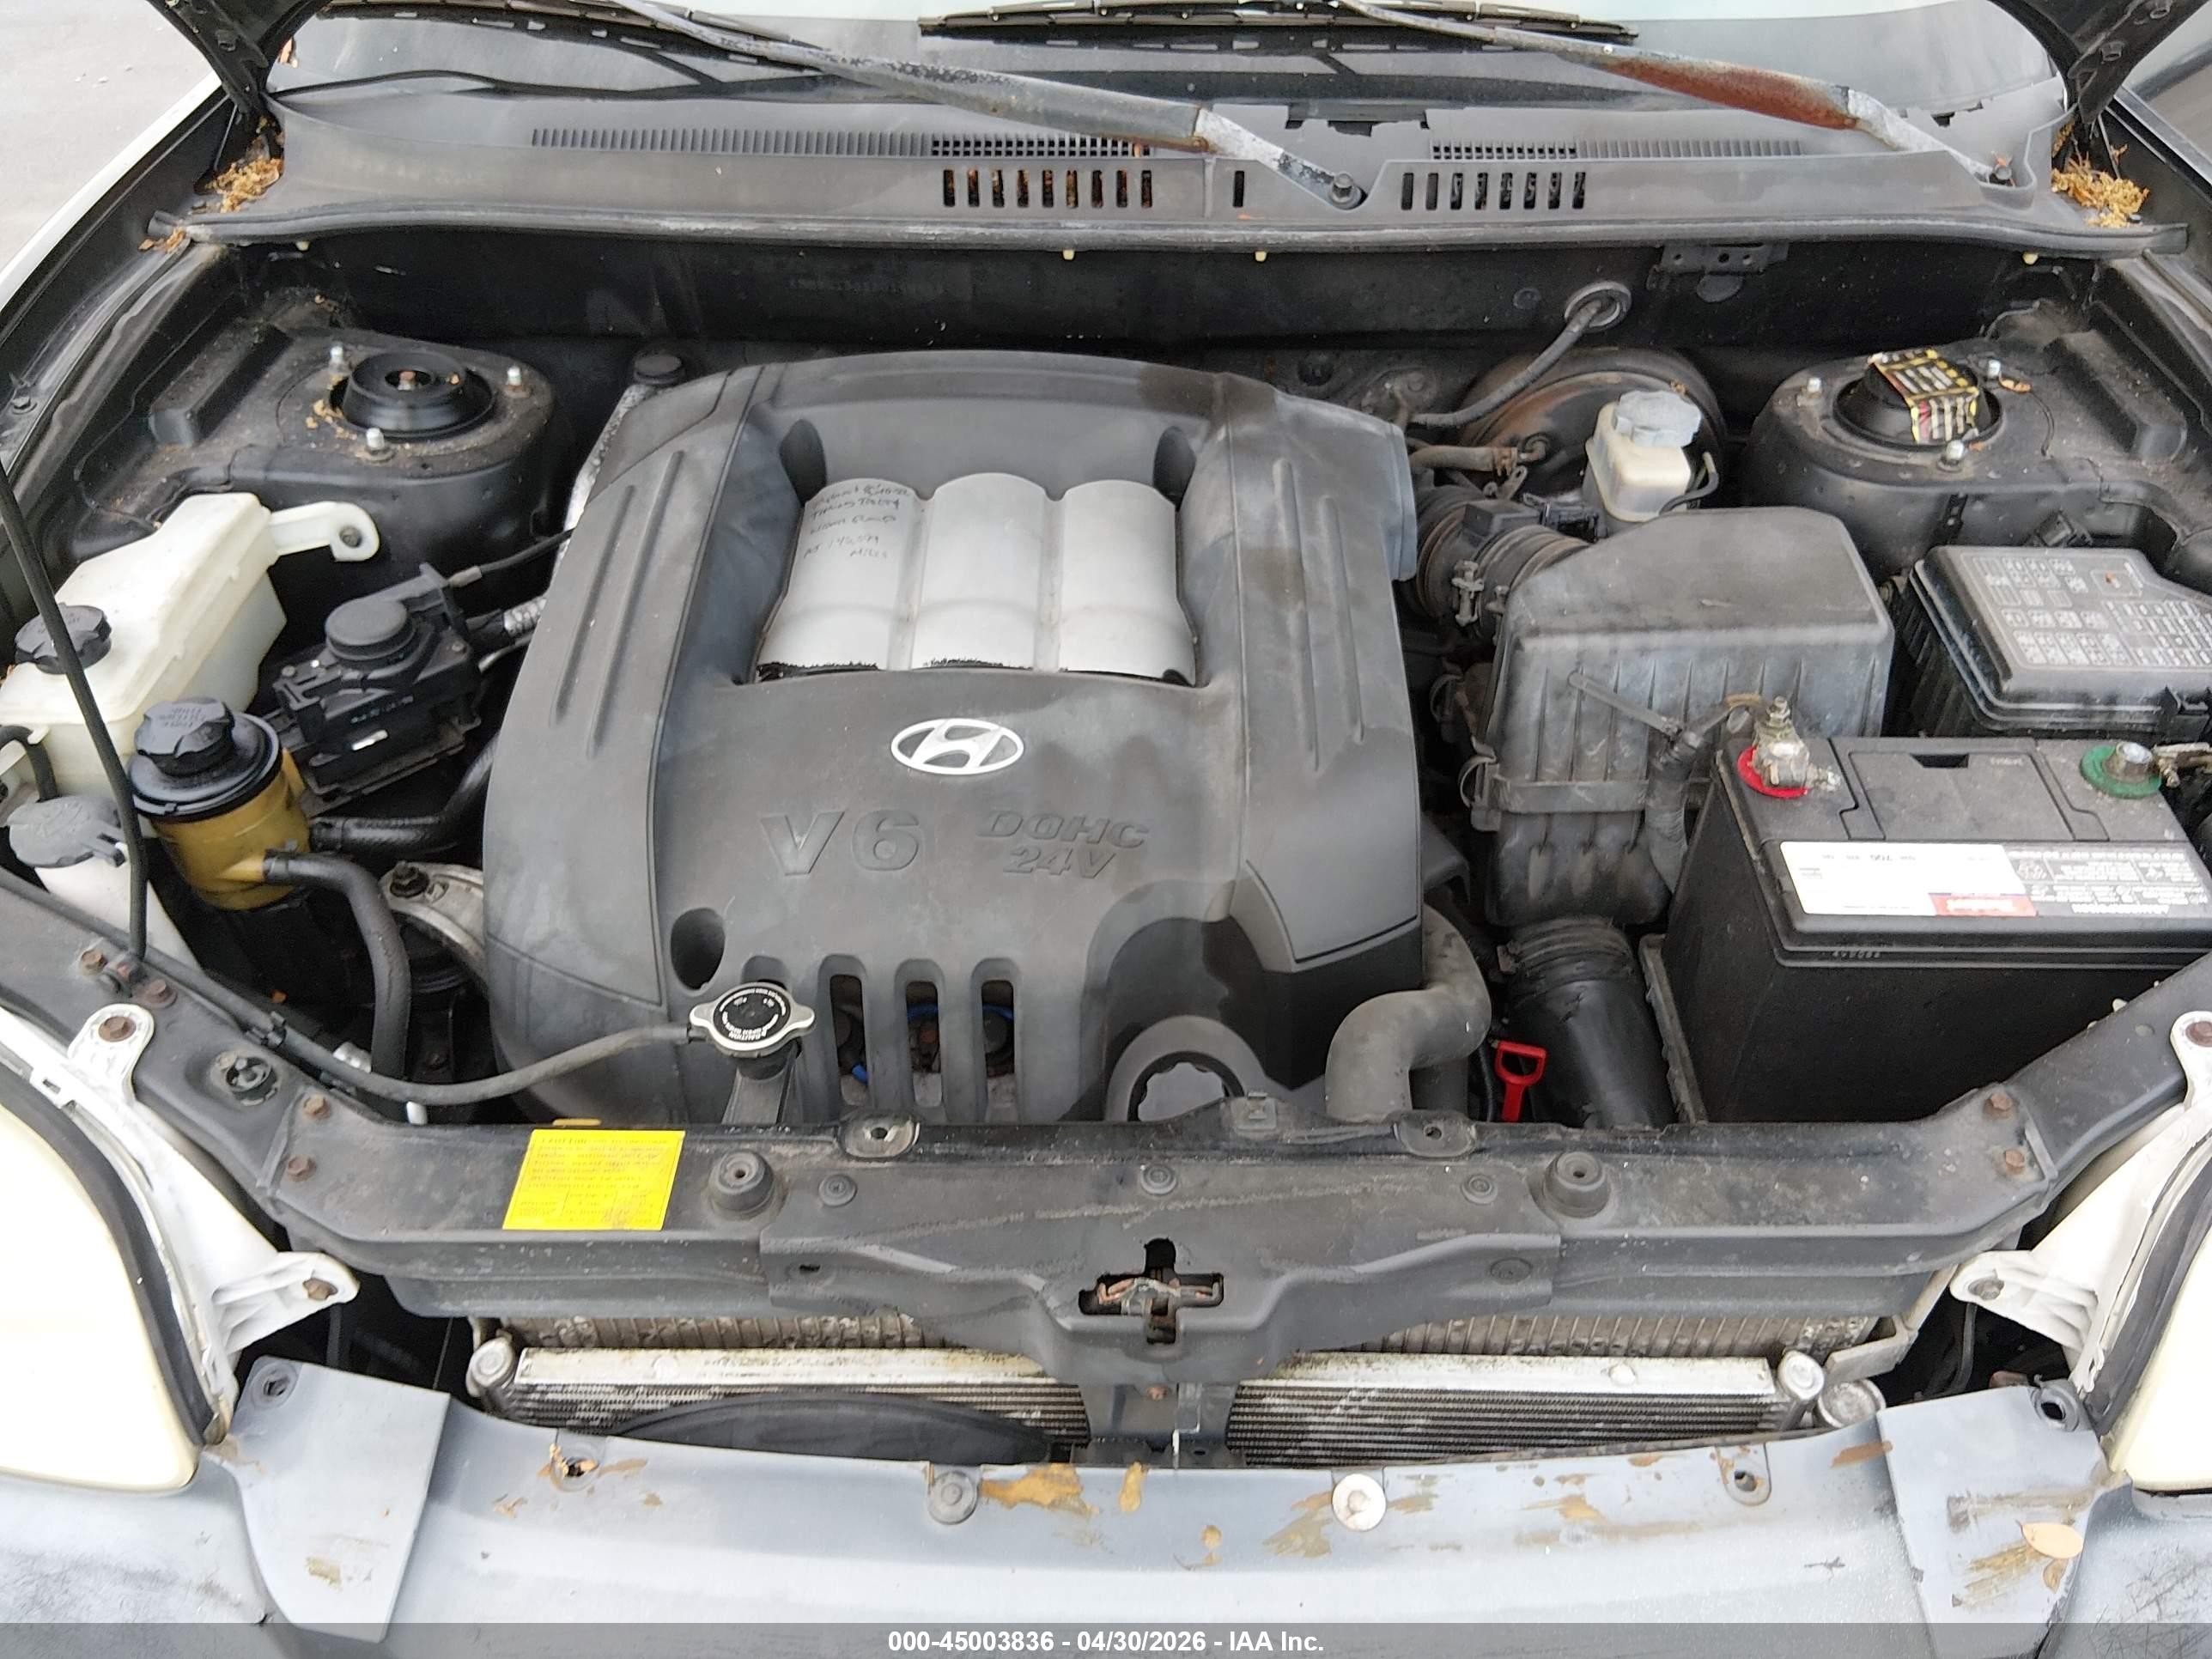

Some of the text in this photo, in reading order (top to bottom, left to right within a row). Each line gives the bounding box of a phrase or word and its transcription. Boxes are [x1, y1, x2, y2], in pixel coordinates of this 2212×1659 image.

[761, 809, 920, 876] V6
[977, 810, 1150, 849] DOHC
[1002, 844, 1118, 879] 24V
